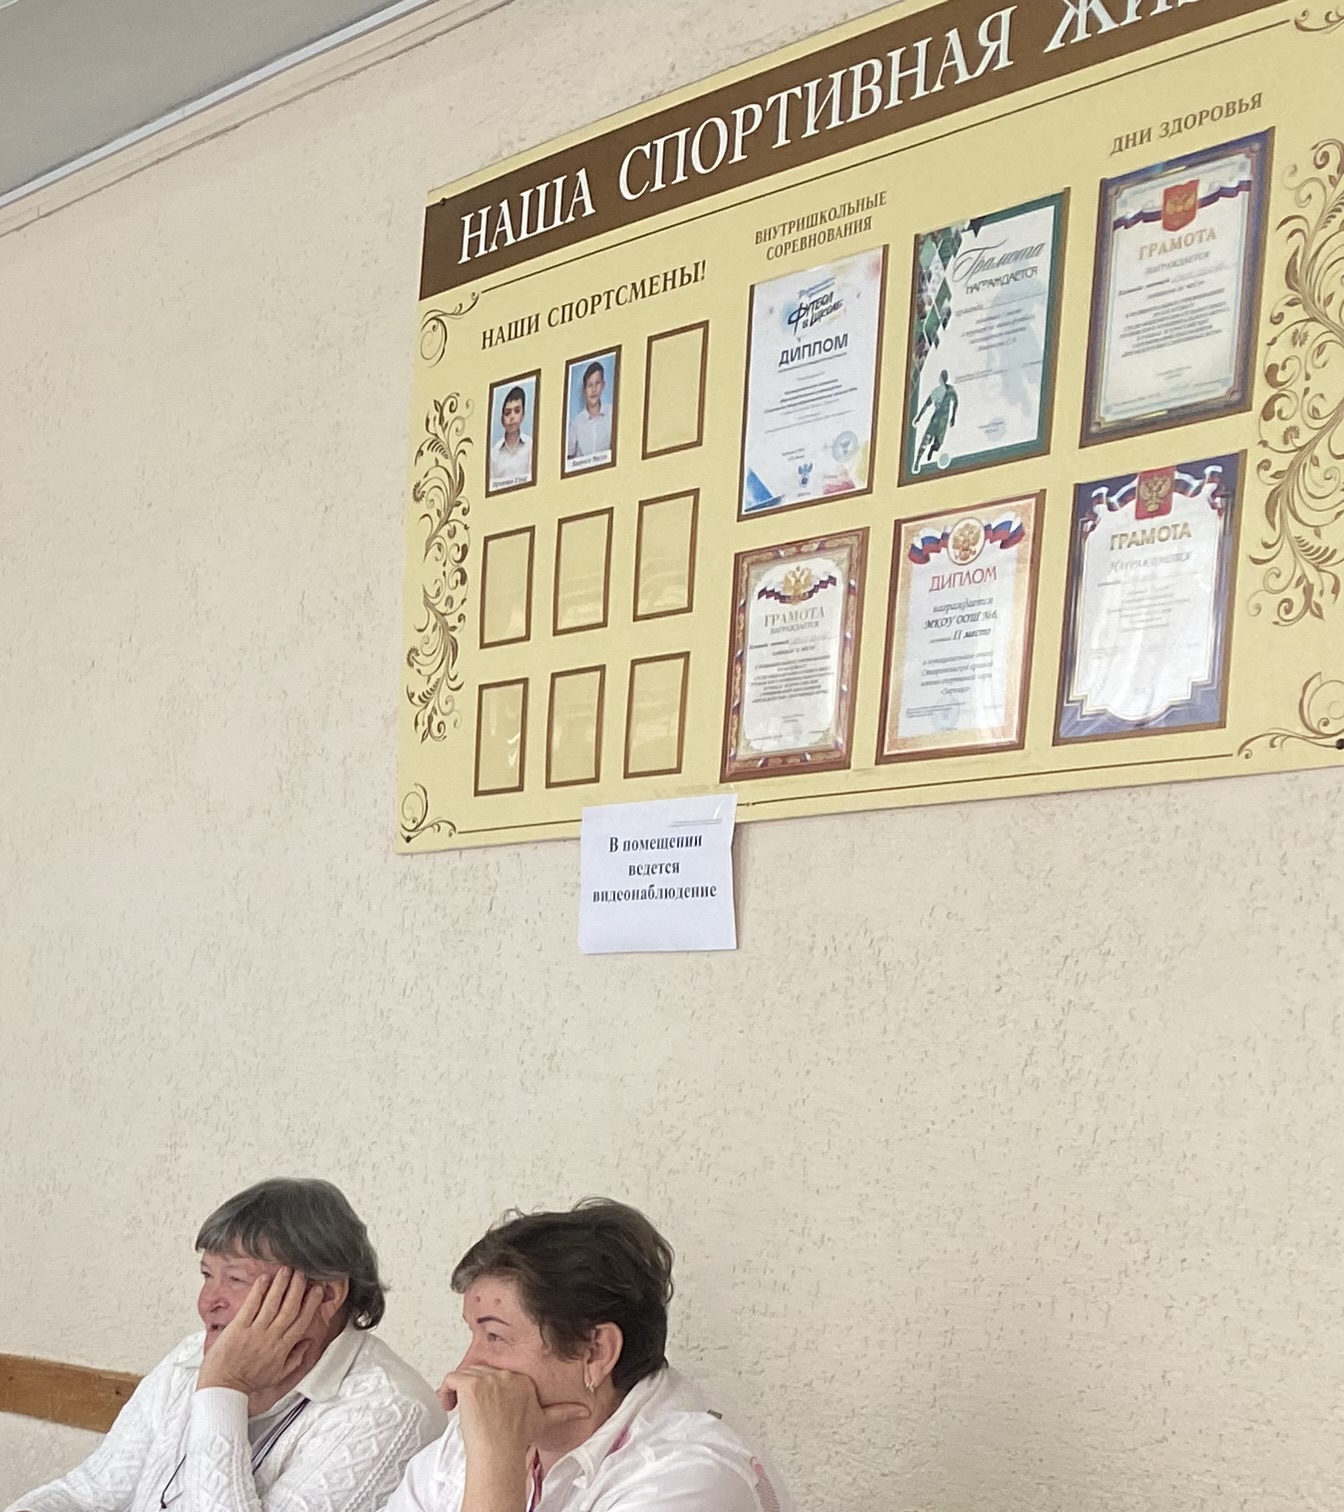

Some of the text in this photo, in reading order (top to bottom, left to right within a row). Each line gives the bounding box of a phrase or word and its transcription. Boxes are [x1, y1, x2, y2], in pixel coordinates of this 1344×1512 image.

[458, 5, 1017, 264] НАША СПОРТИВНАЯ
[1110, 91, 1263, 157] ДНИ ЗДОРОВЬЯ
[755, 190, 889, 246] ВНУТРИШКОЛЬНЫЕ
[766, 216, 873, 262] СОРЕВНОВАНИЯ
[1138, 228, 1217, 261] ГРАМОТА
[952, 237, 1046, 284] Грамота
[481, 259, 707, 351] НАШИ СПОРТСМЕНЫ!
[778, 333, 849, 368] ДИПЛОМ
[1109, 522, 1192, 551] ГРАМОТА
[928, 566, 998, 593] ДИПЛОМ
[764, 606, 826, 627] ГРАМОТА
[609, 834, 703, 853] В помещении
[628, 862, 680, 877] ведется
[592, 883, 717, 904] видеонаблюдение
